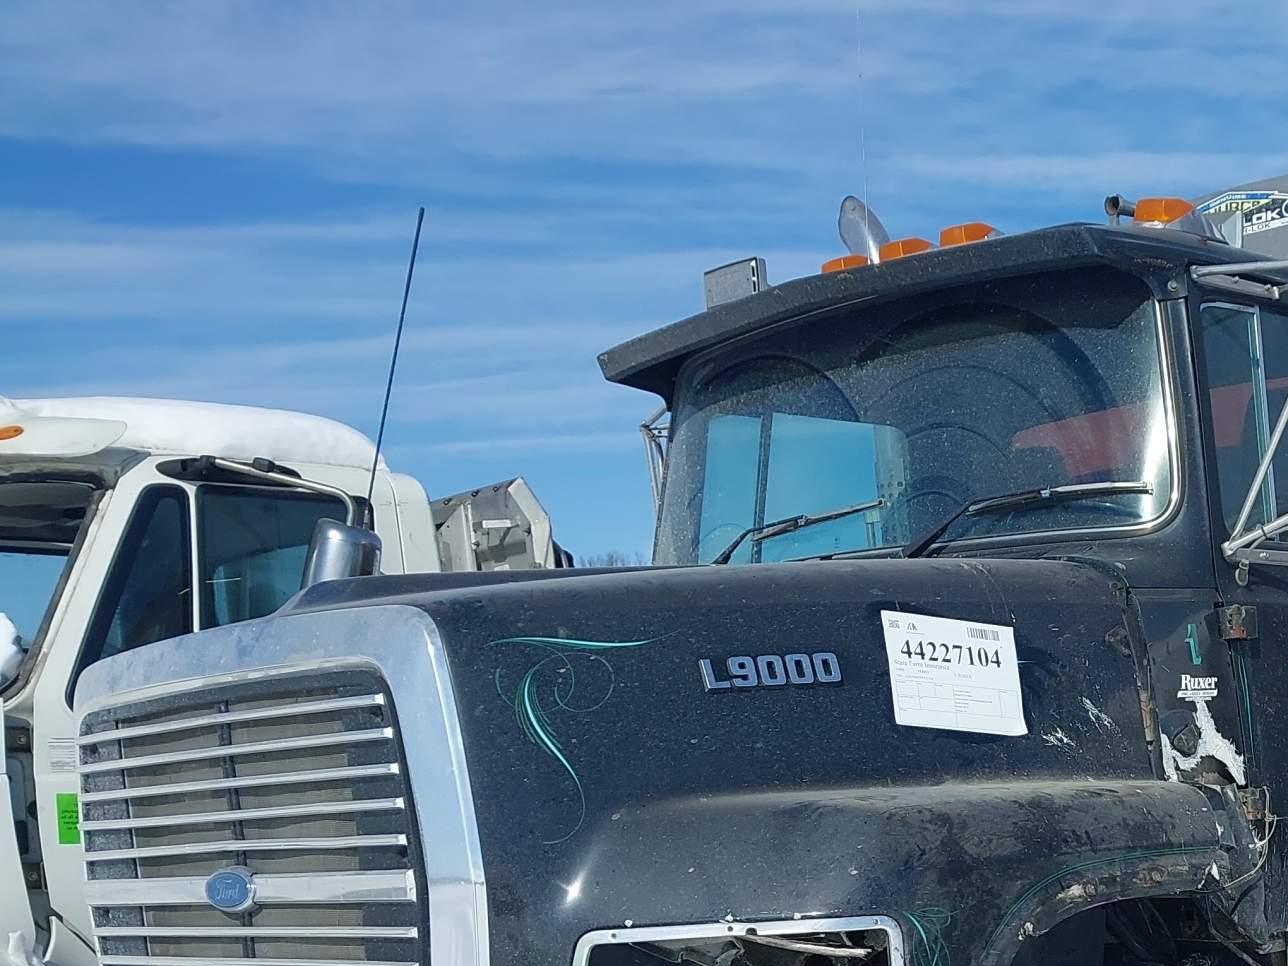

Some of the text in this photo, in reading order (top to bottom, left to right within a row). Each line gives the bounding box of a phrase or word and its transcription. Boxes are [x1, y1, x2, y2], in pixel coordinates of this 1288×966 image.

[901, 639, 1003, 668] 44227104
[698, 652, 842, 692] L9000
[1179, 674, 1218, 691] Ruxer
[215, 878, 240, 899] Ford
